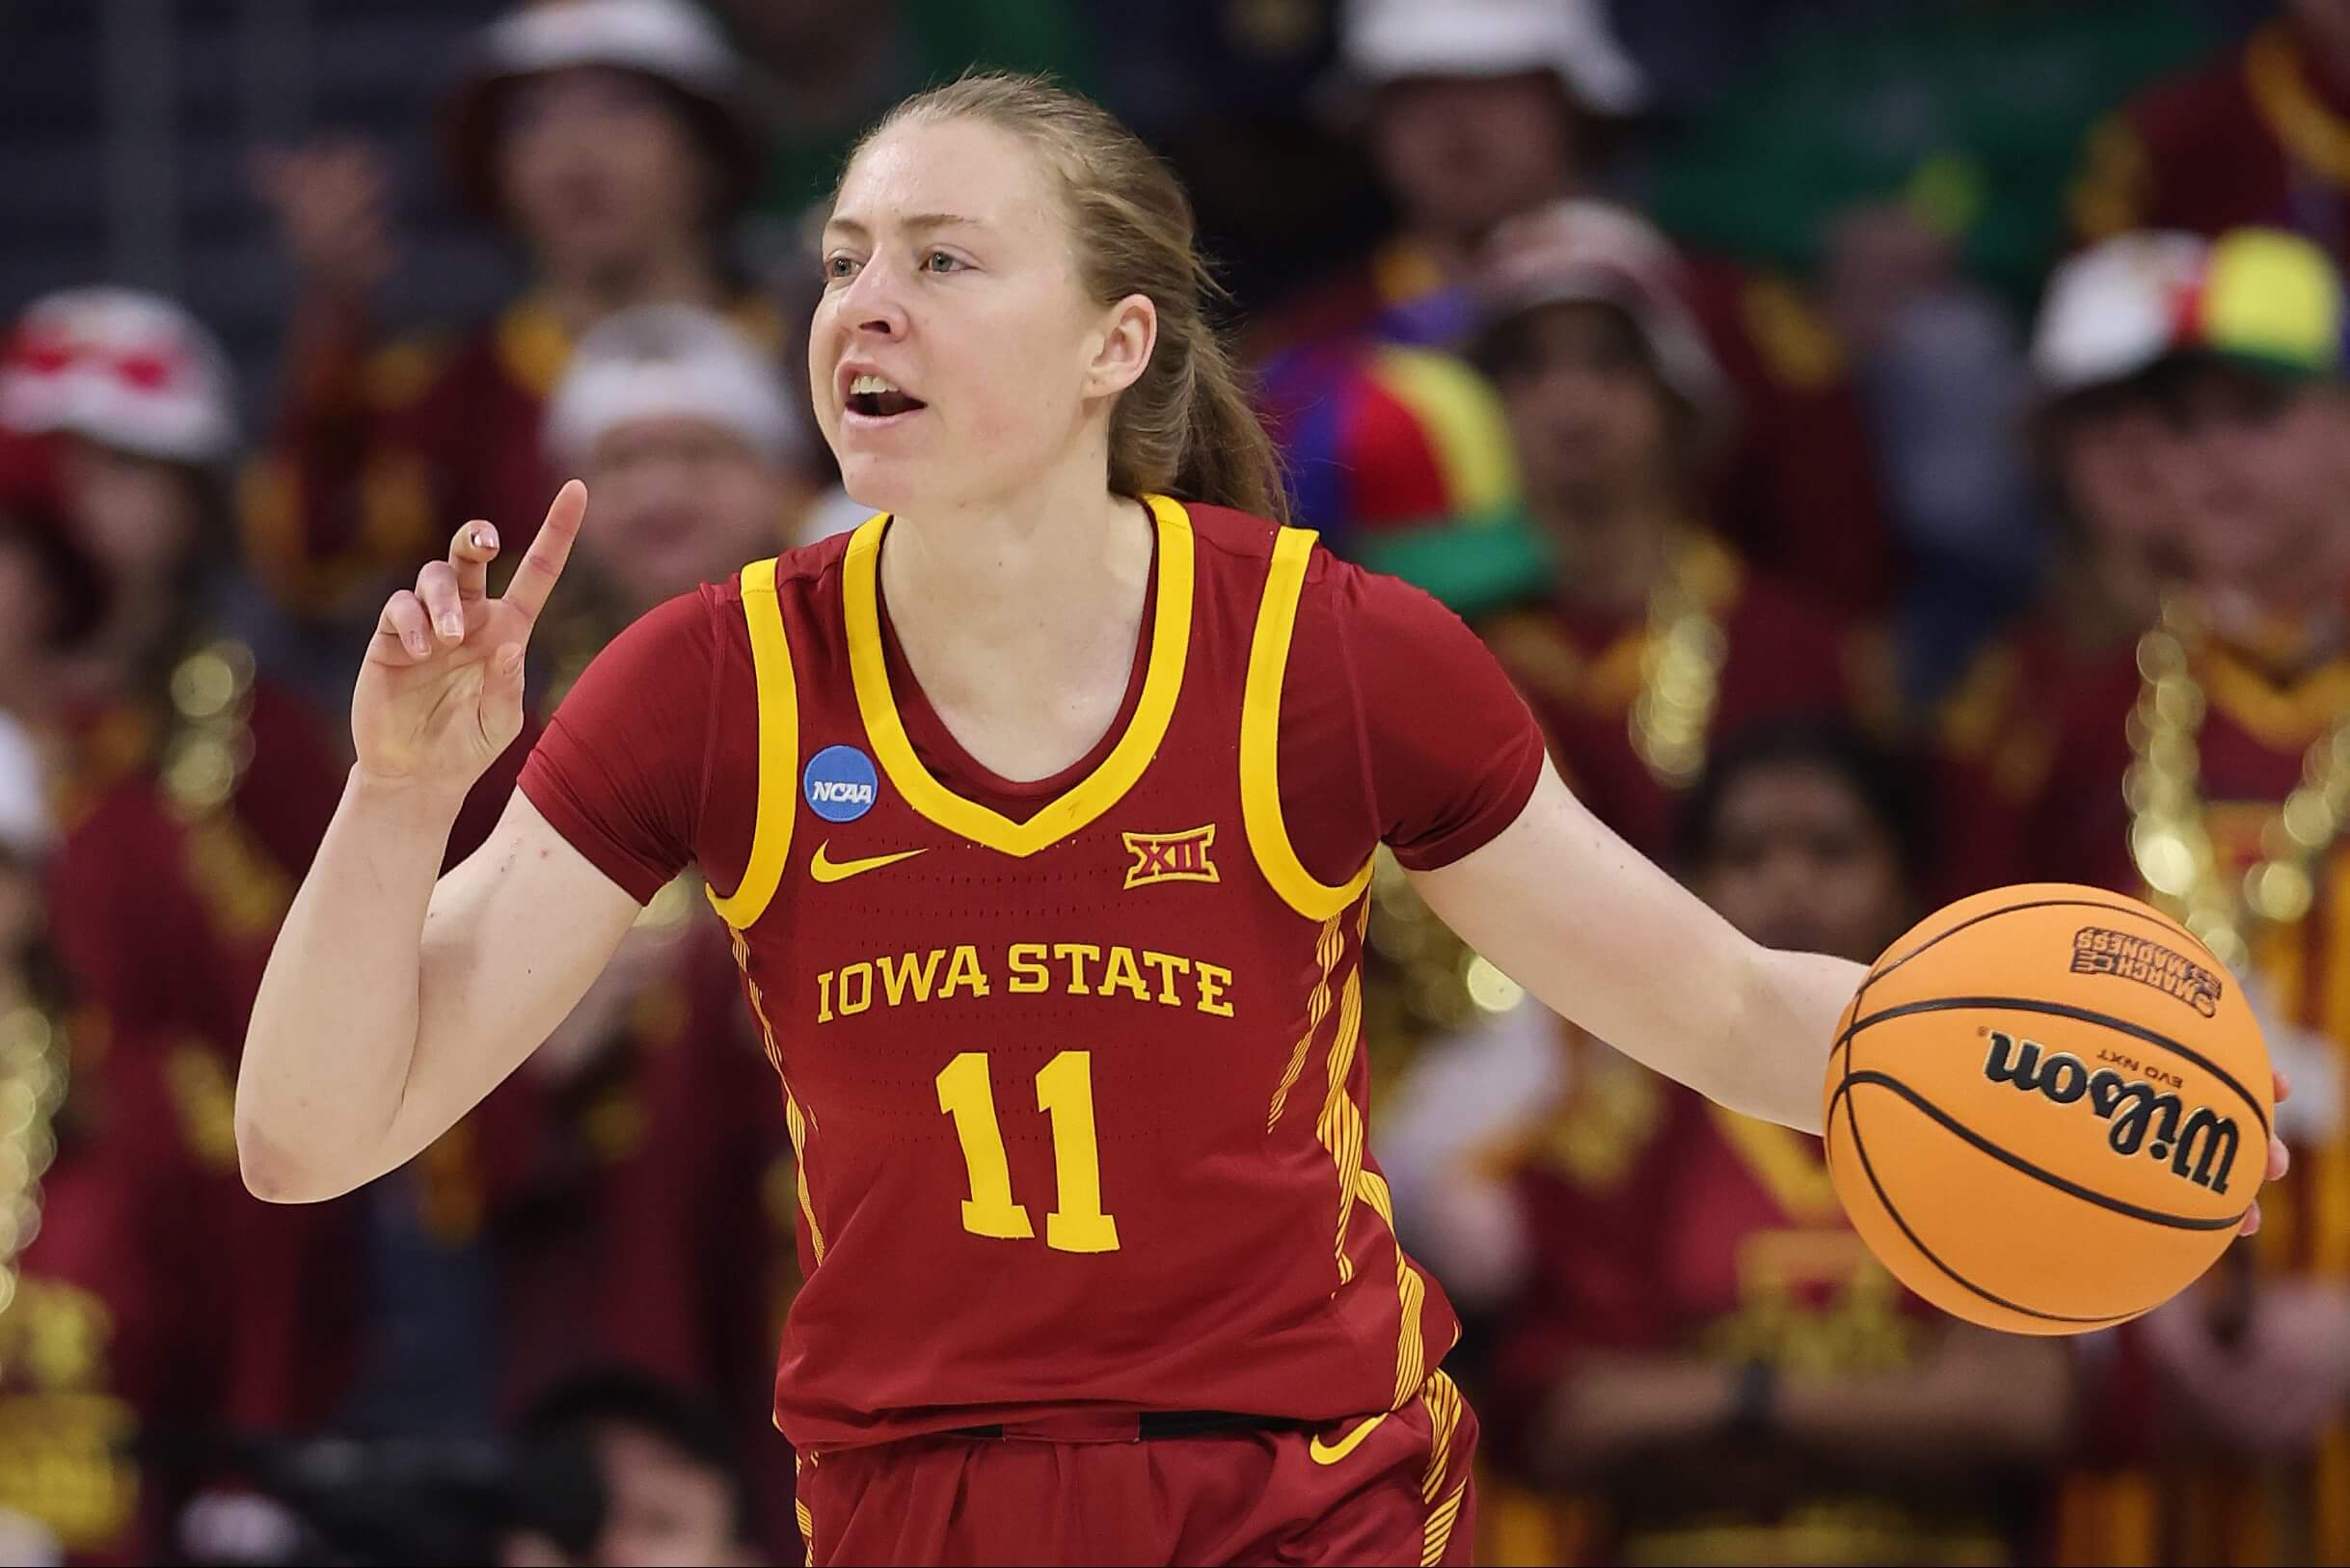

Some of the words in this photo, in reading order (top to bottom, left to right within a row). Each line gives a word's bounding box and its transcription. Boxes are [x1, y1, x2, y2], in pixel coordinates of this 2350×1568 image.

[812, 780, 872, 803] NCAA
[1130, 832, 1211, 880] XII
[2075, 929, 2189, 977] MADNESS
[817, 945, 990, 1024] IOWA
[1008, 943, 1234, 1017] STATE
[2116, 956, 2198, 1005] MARCH
[2097, 1049, 2140, 1072] NXT
[2146, 1067, 2183, 1089] EVO
[1985, 1029, 2239, 1195] Wilson
[934, 1051, 1121, 1254] 11
